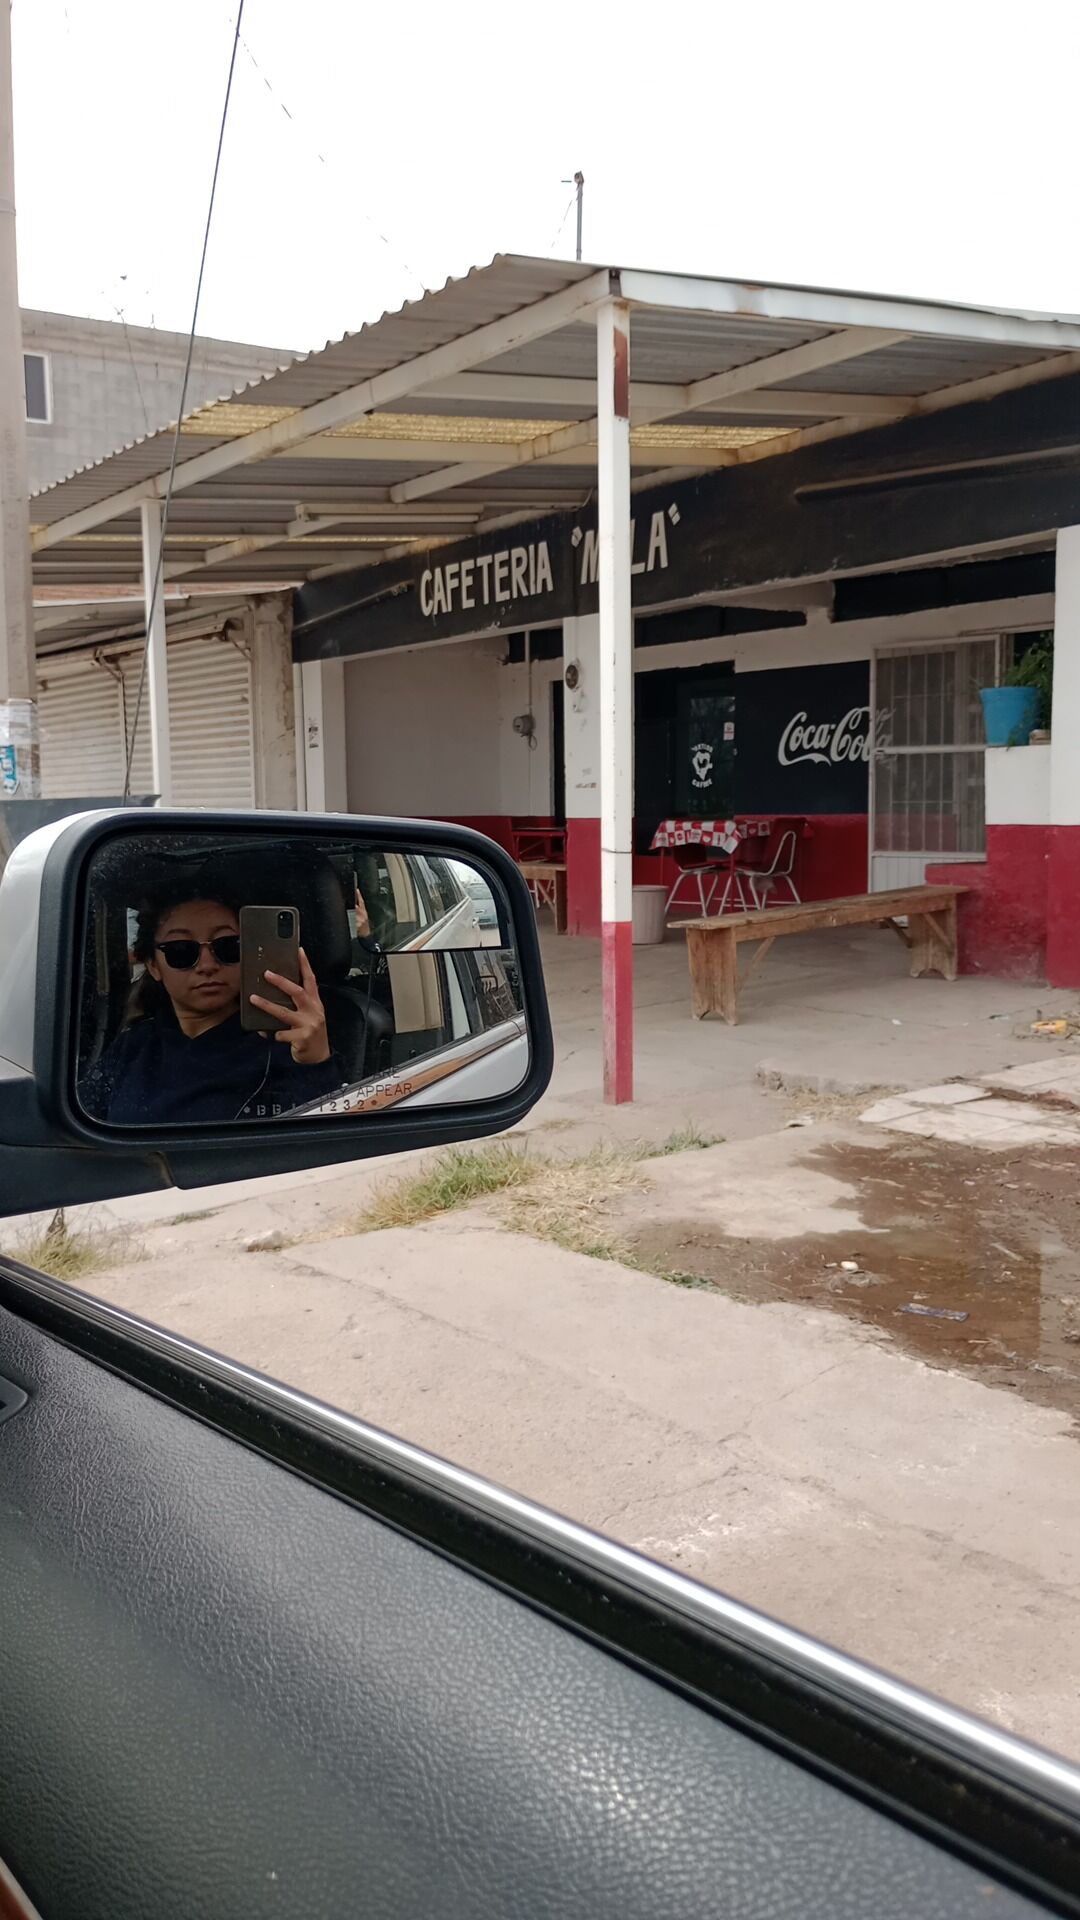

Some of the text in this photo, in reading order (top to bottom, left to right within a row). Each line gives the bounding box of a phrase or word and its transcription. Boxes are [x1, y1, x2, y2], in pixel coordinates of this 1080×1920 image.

[420, 502, 681, 617] CAFETERIA "MLA"
[777, 706, 896, 767] Coca-Cola
[356, 1083, 413, 1098] APPEAR
